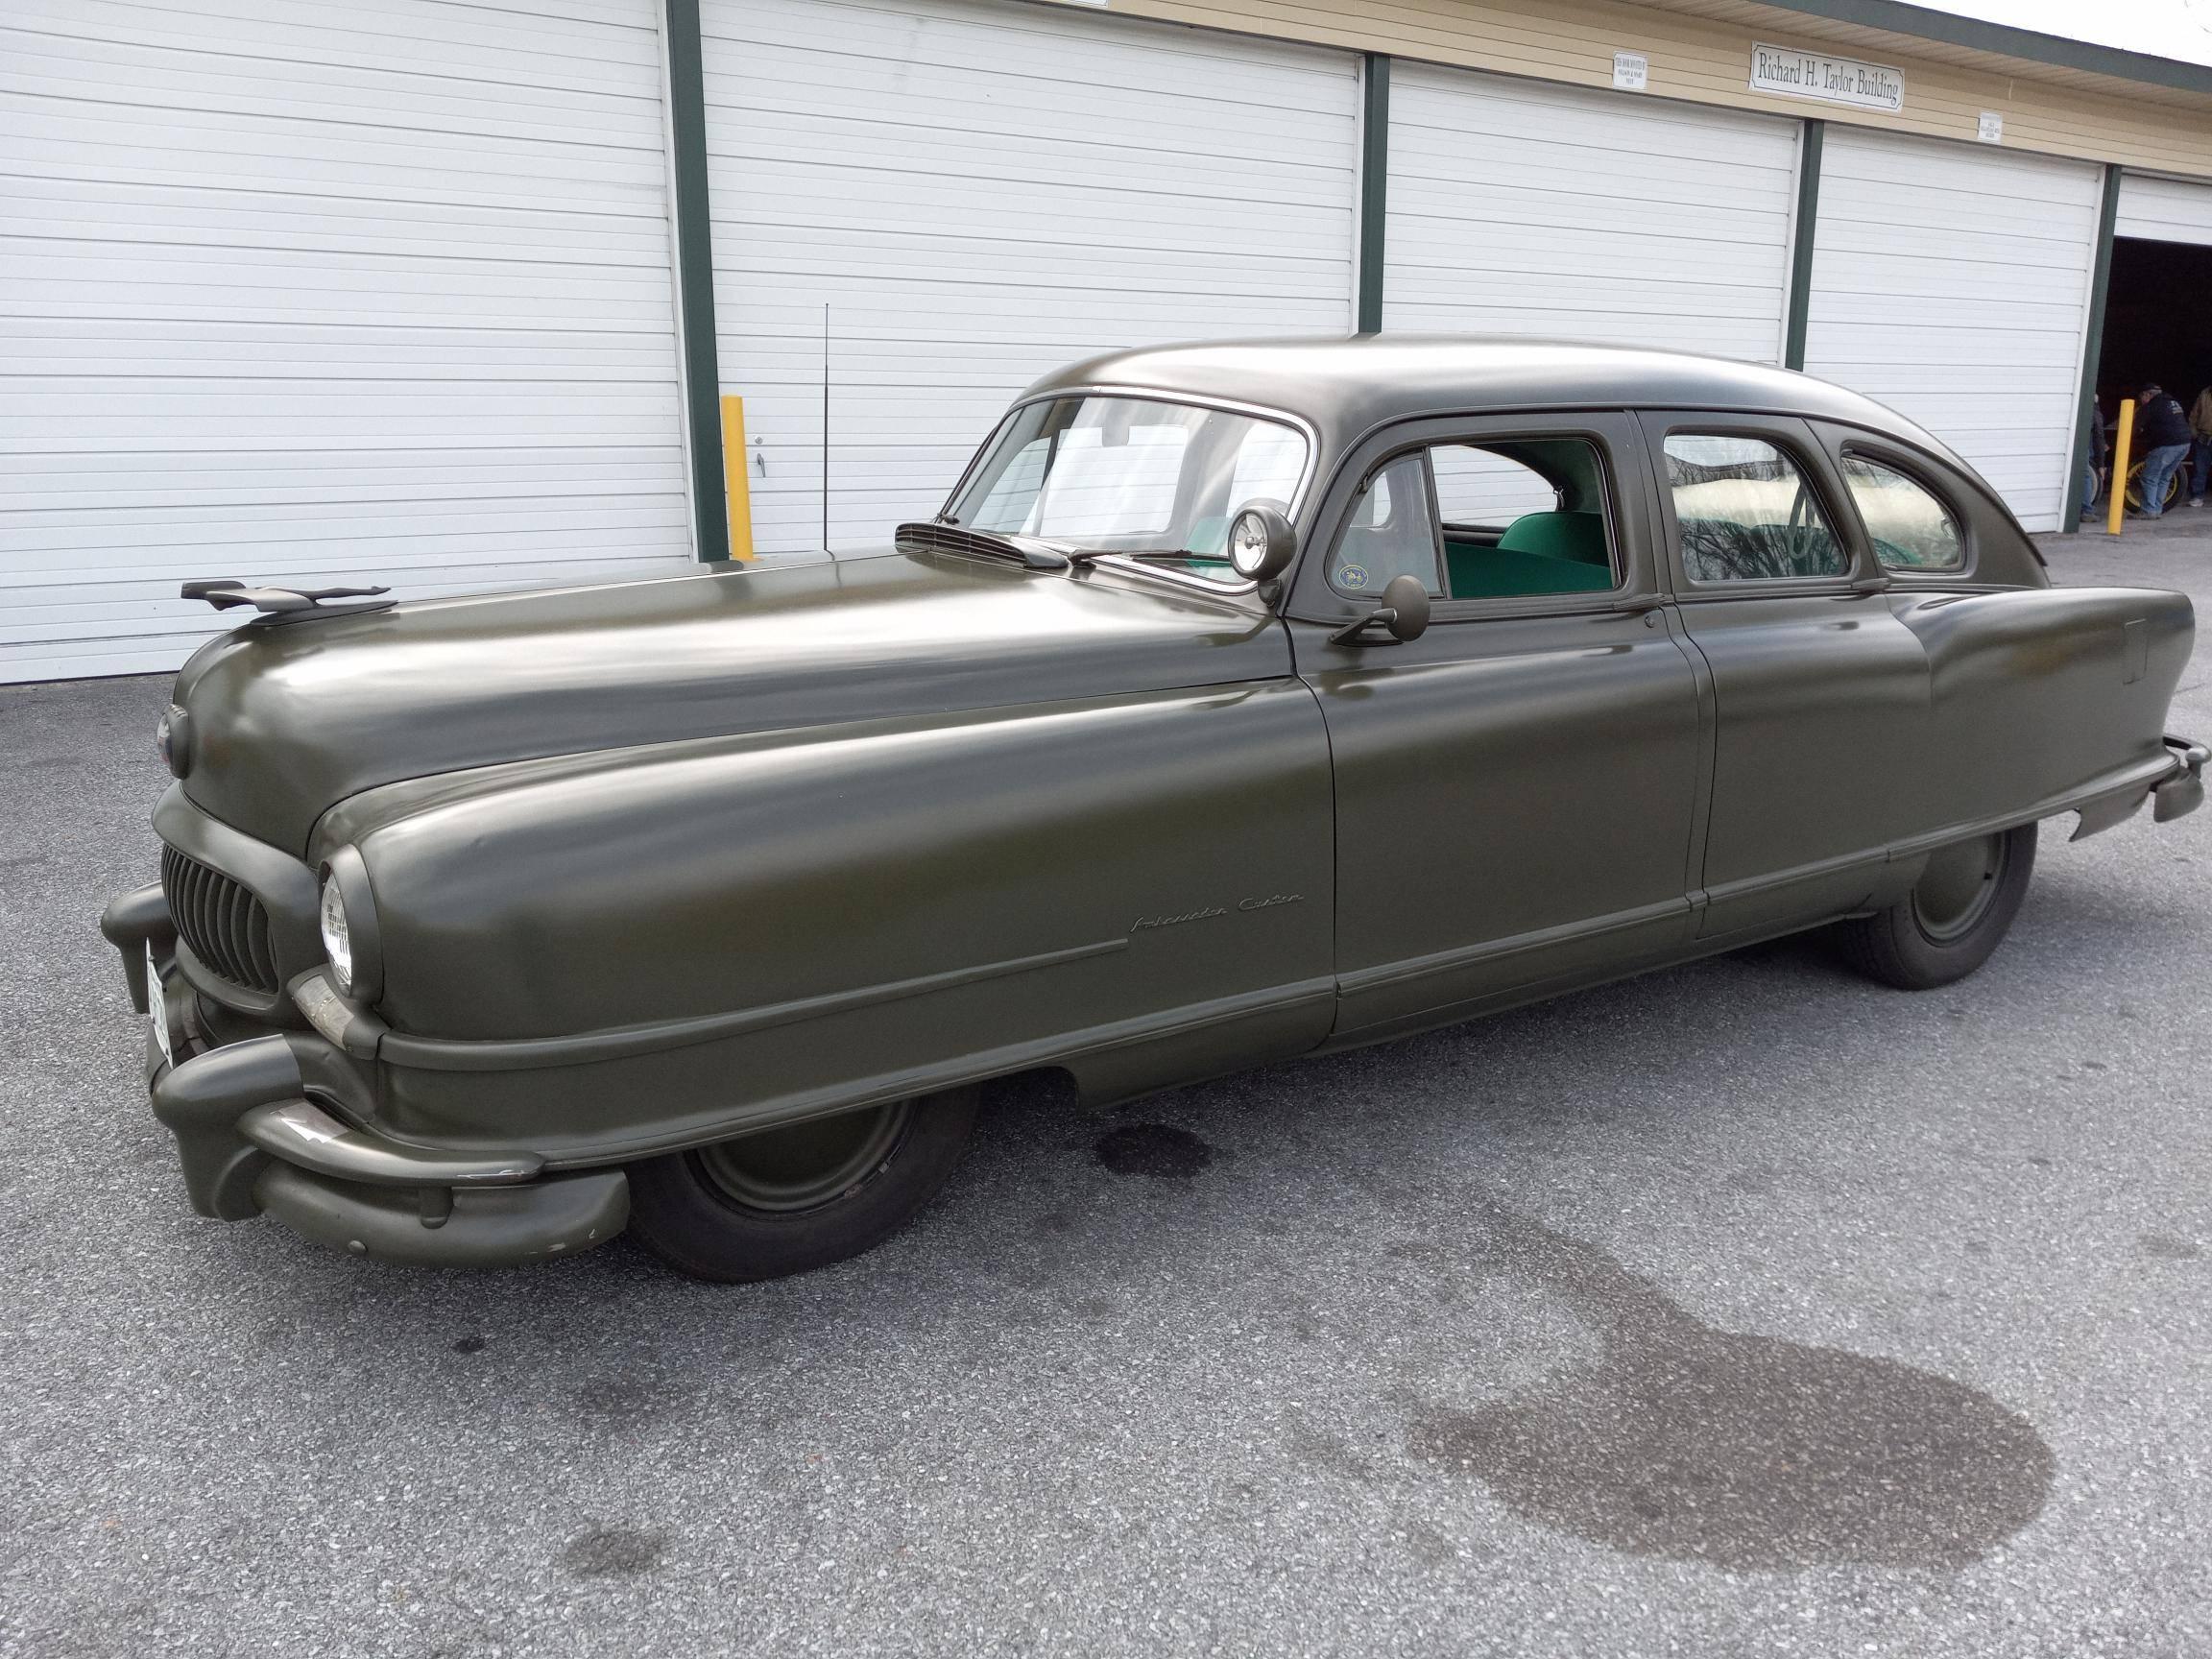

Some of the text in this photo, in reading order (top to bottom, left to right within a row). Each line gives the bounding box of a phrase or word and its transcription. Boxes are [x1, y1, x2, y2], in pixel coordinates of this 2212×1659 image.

[1758, 52, 1899, 105] Richard H. Taylor Building
